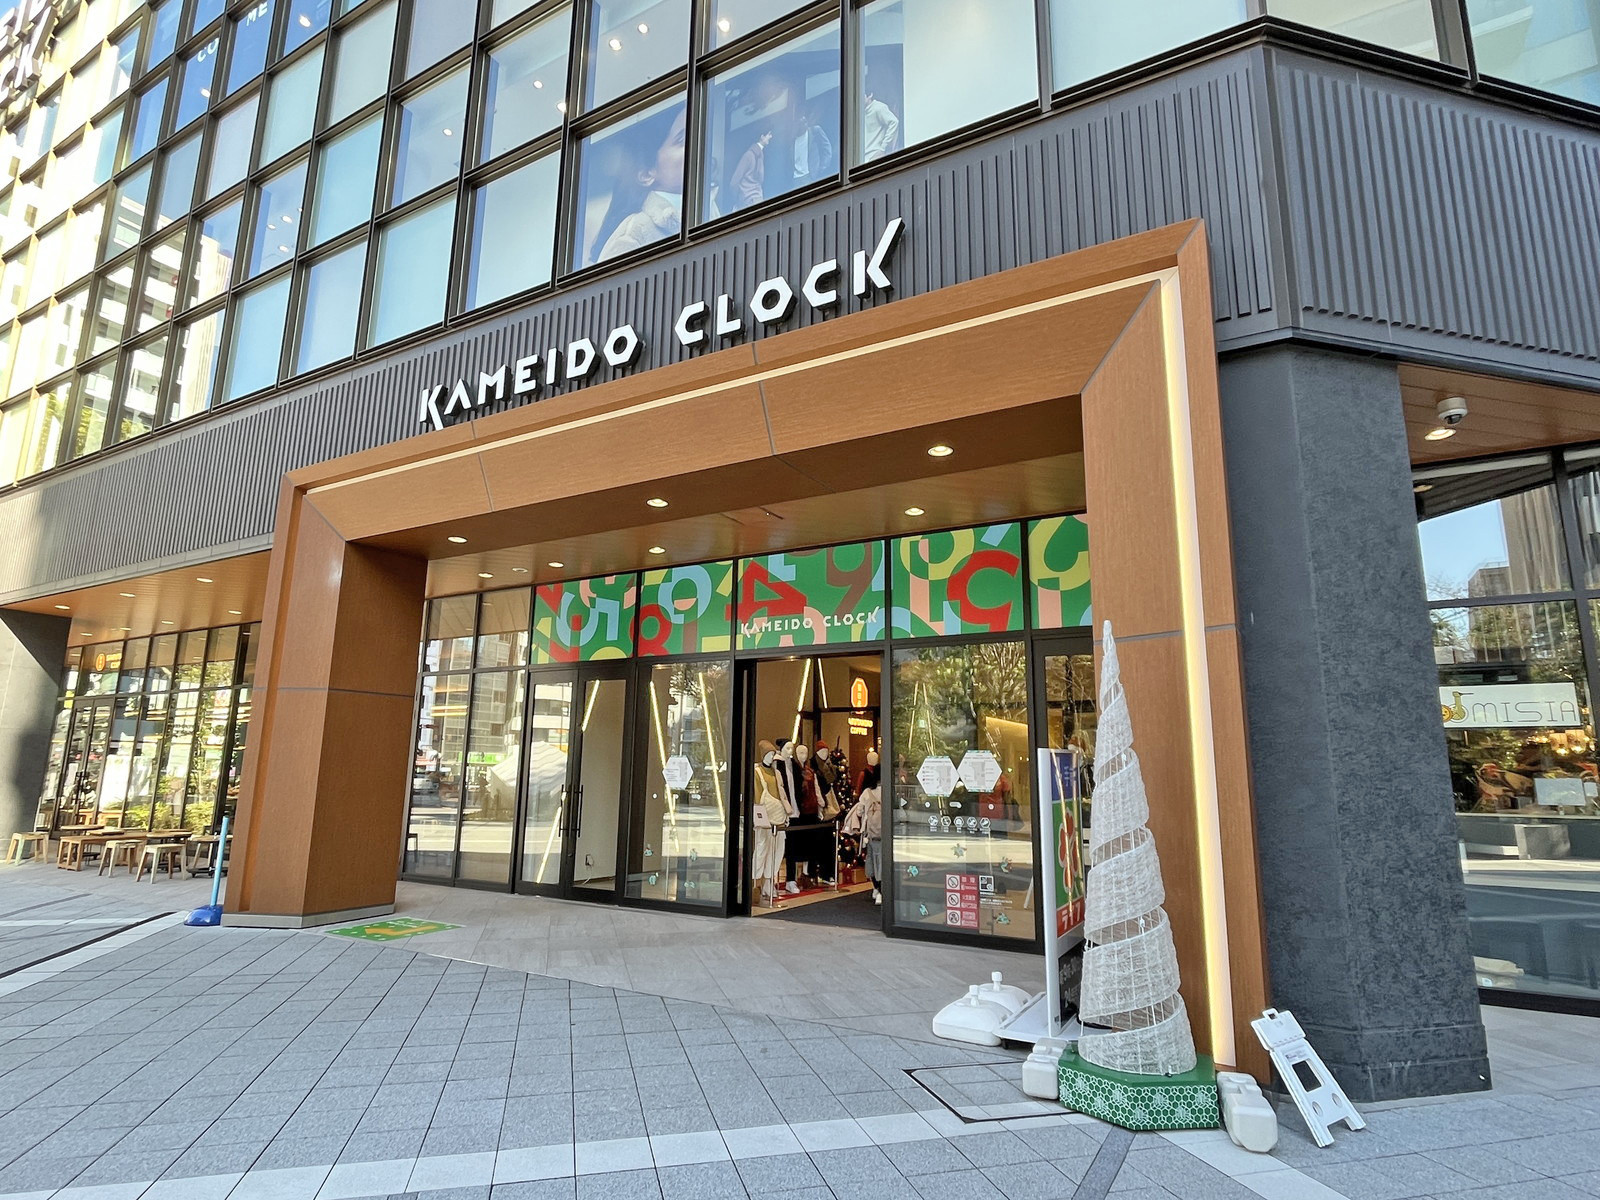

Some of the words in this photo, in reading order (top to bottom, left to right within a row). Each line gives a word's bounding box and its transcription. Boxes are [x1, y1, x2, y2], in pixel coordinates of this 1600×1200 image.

[419, 324, 639, 431] KAMEIDO
[674, 217, 903, 346] CLOCK
[741, 617, 814, 638] KAMEIDO
[822, 605, 880, 628] CLOCK
